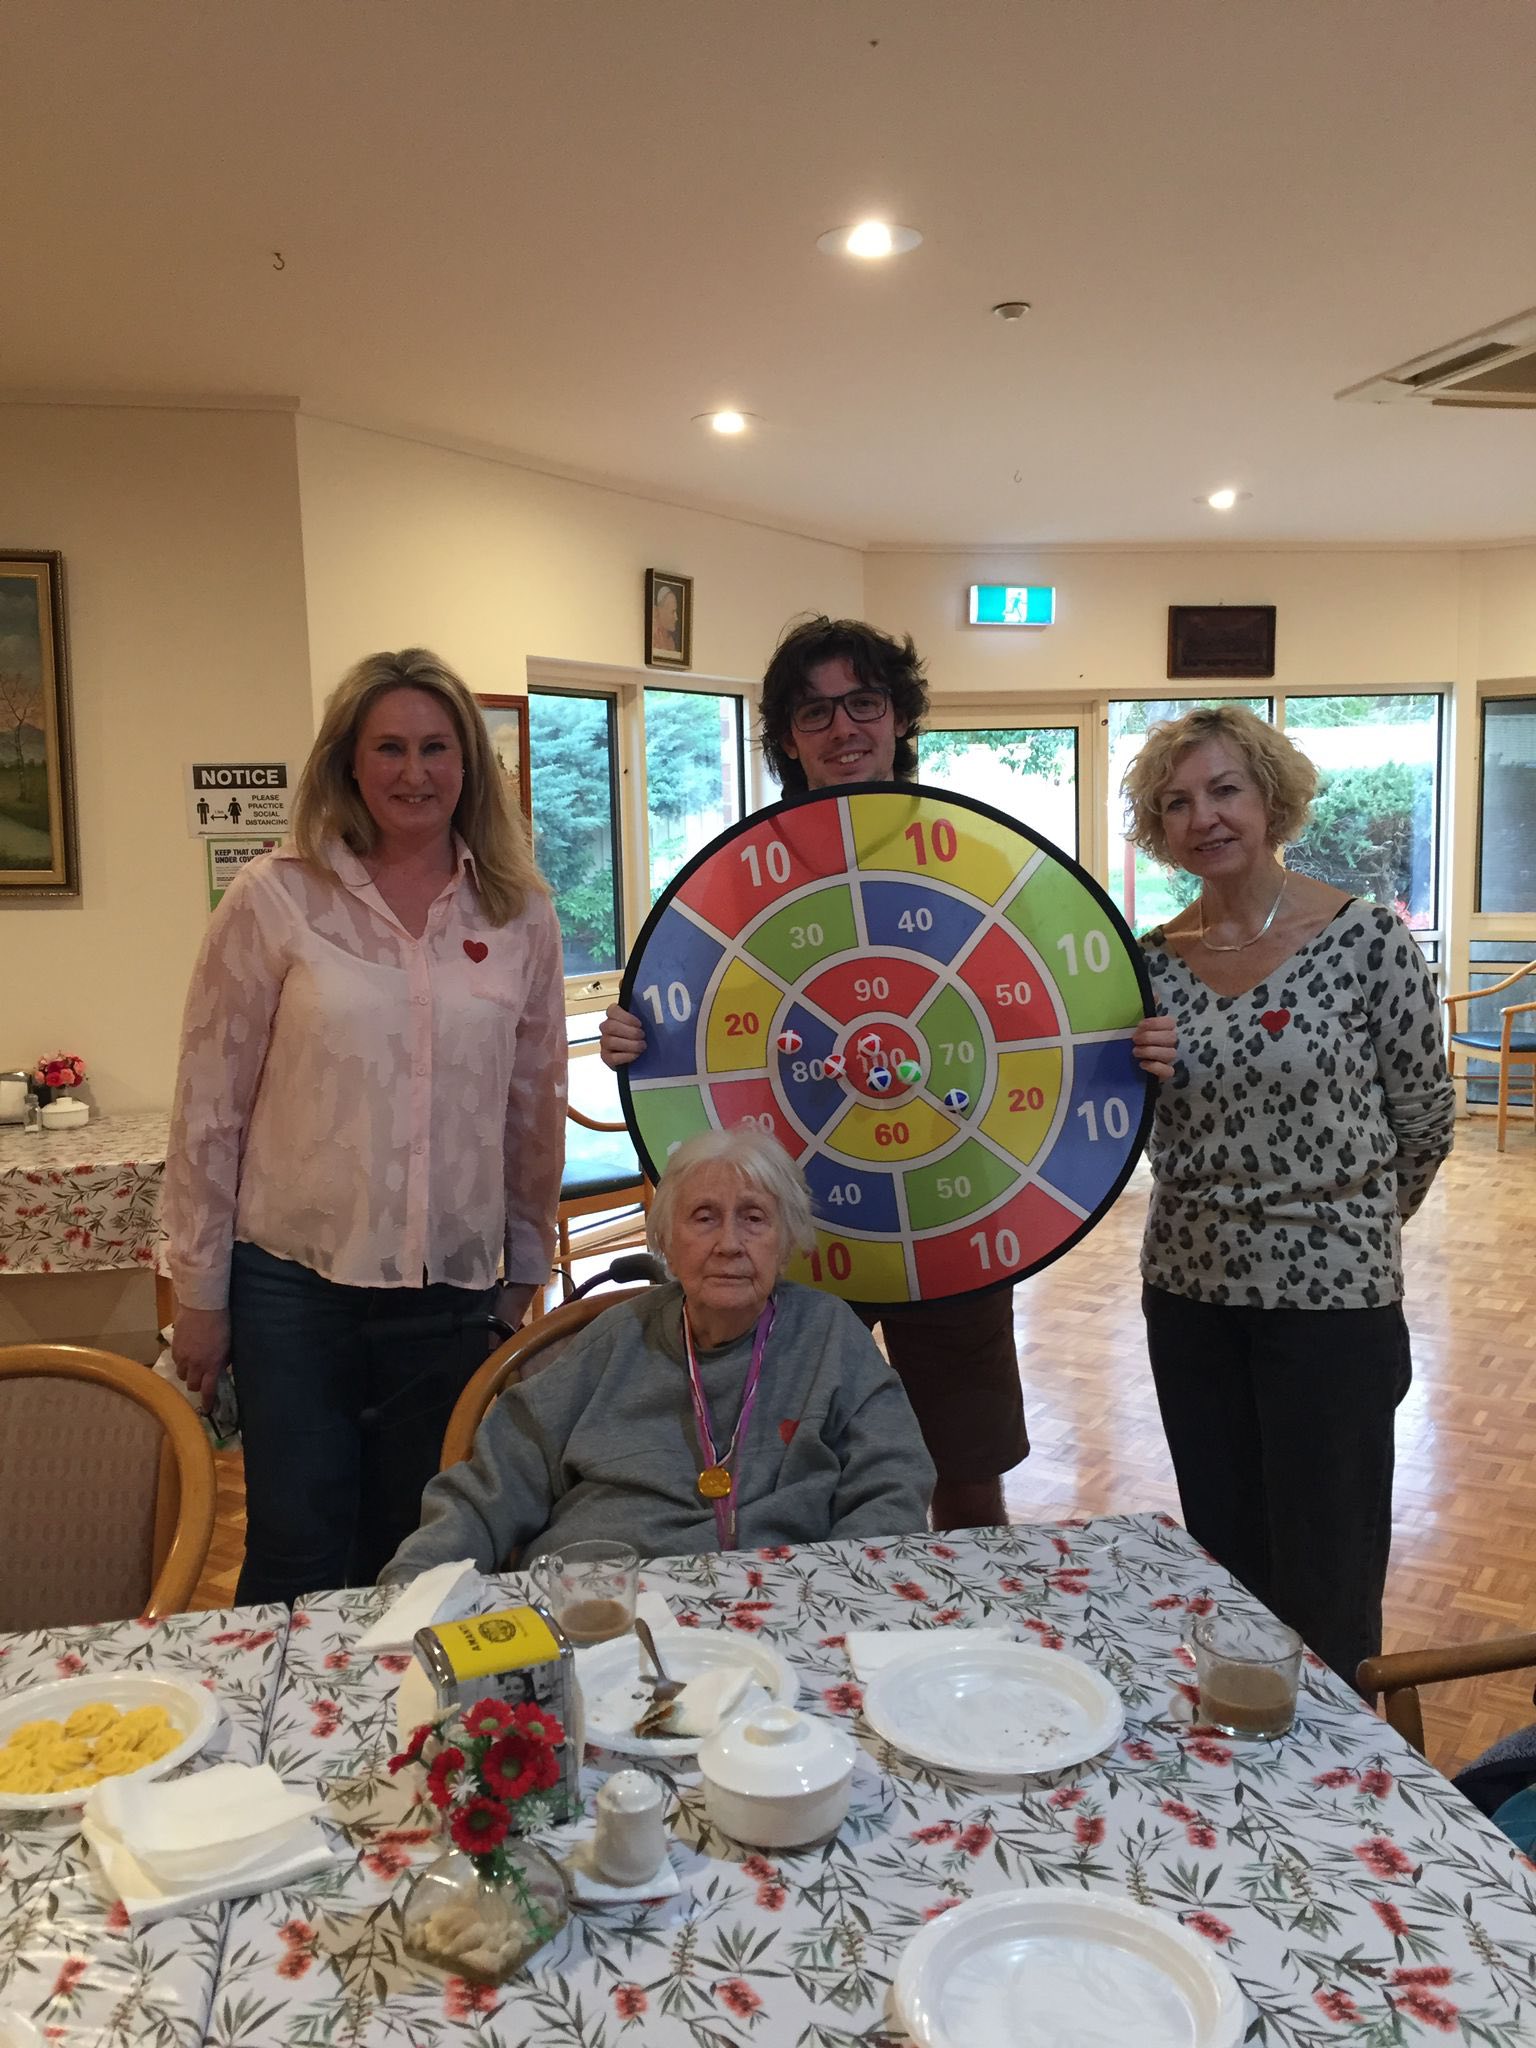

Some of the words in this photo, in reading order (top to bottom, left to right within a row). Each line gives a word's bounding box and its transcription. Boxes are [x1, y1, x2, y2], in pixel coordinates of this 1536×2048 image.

[201, 769, 279, 785] NOTICE
[905, 819, 958, 866] 10
[215, 856, 238, 864] UNDER
[740, 840, 791, 887] 10
[898, 908, 934, 934] 40
[789, 923, 824, 950] 30
[1057, 929, 1111, 977] 10
[854, 977, 889, 1001] 90
[995, 981, 1031, 1006] 50
[642, 980, 692, 1025] 10
[724, 1011, 759, 1036] 20
[856, 1047, 907, 1074] 100
[938, 1040, 975, 1065] 70
[791, 1058, 826, 1083] 80
[1008, 1087, 1044, 1112] 20
[1077, 1097, 1130, 1142] 10
[874, 1122, 910, 1146] 60
[828, 1183, 862, 1206] 40
[936, 1176, 972, 1199] 50
[803, 1241, 852, 1282] 10
[970, 1229, 1020, 1271] 10
